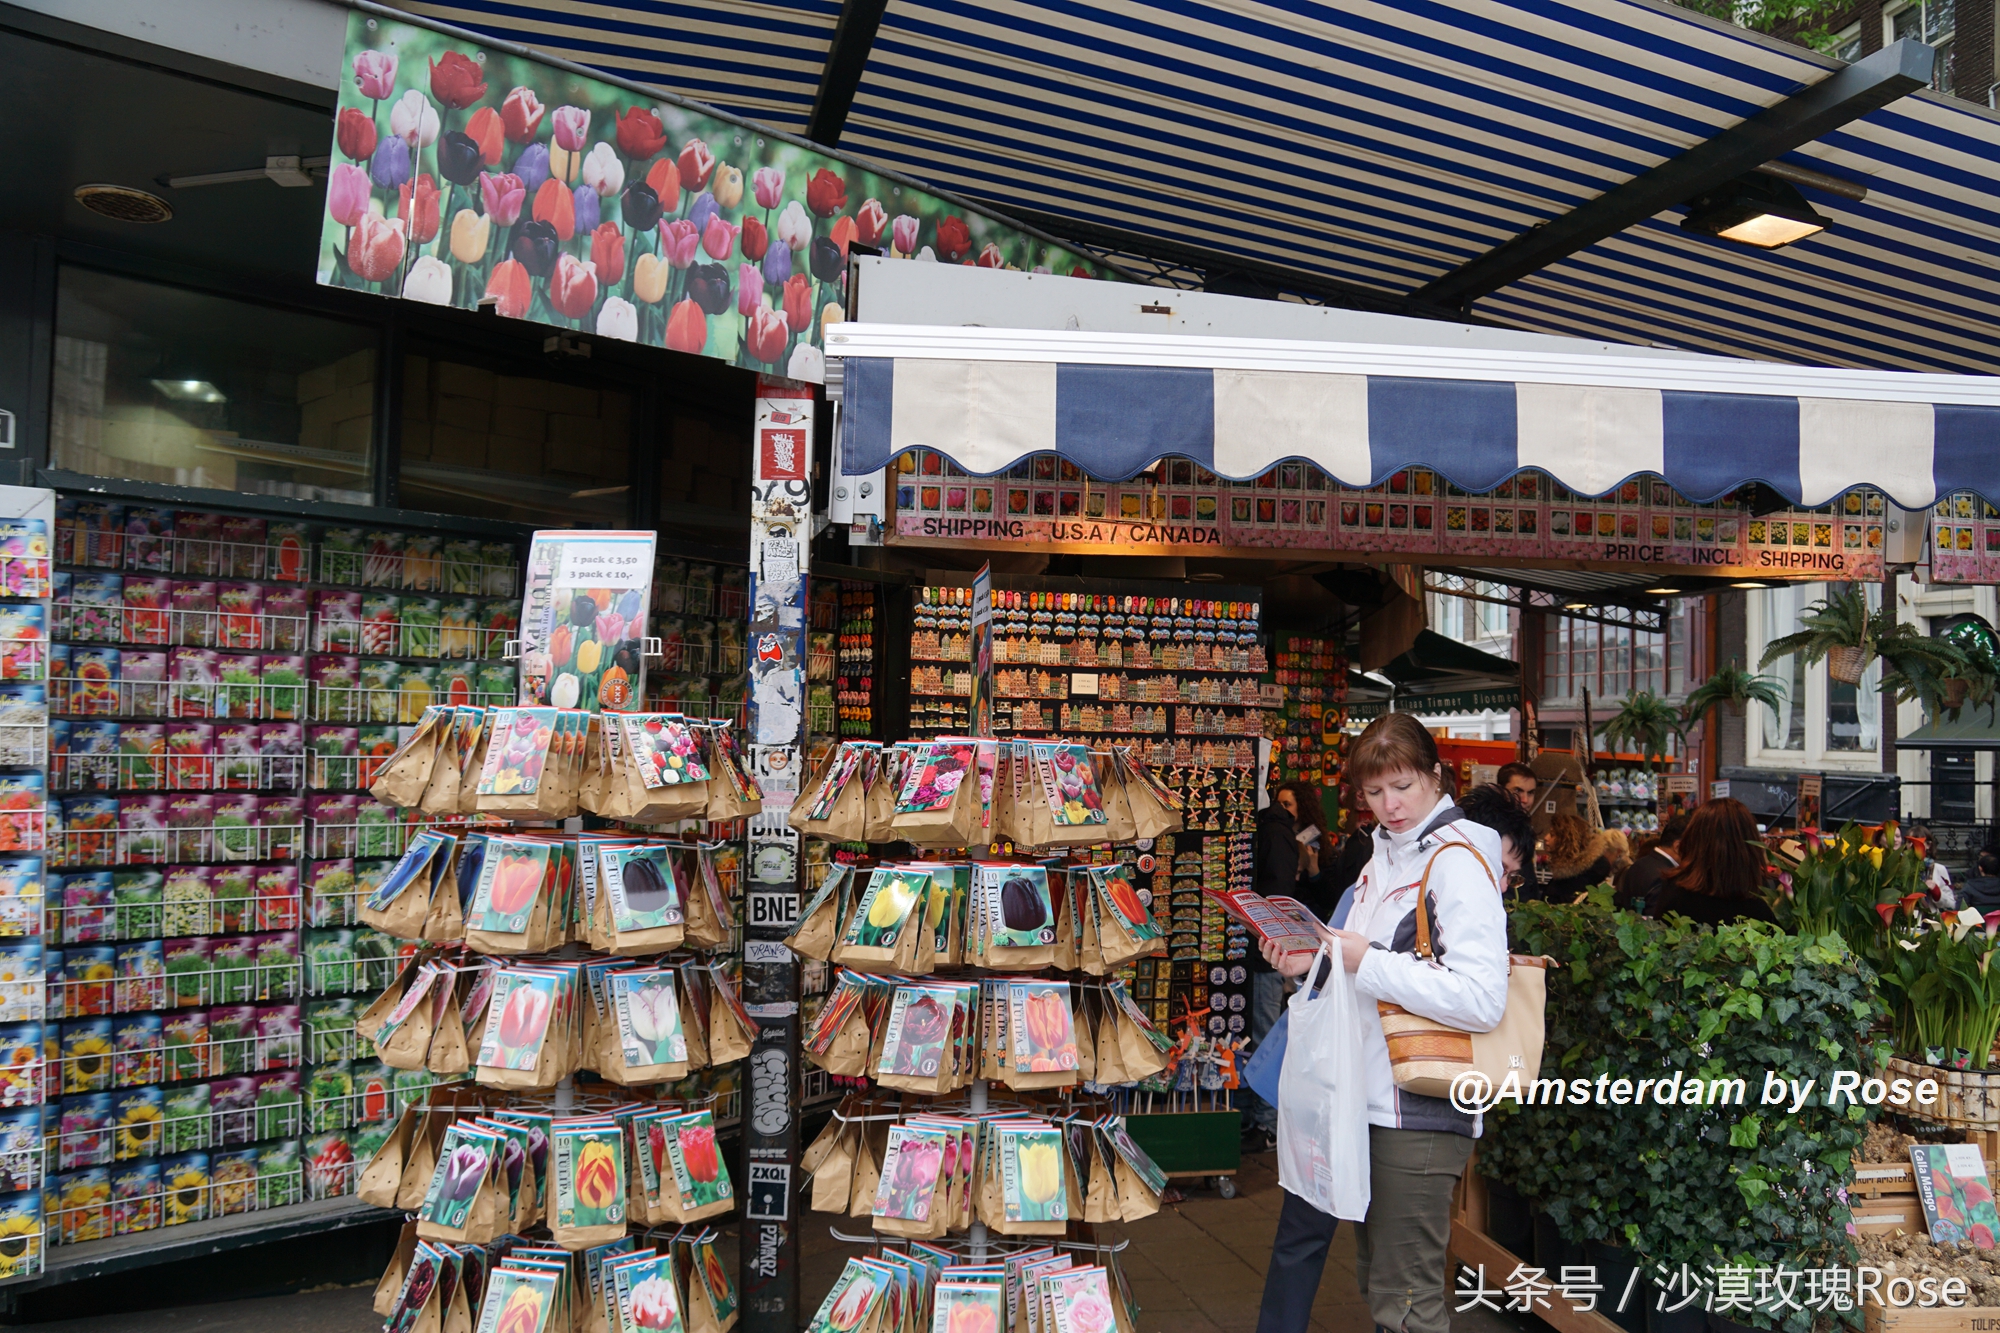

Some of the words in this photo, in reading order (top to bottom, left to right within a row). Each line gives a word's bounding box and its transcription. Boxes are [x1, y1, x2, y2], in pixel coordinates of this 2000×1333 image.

[923, 517, 1024, 538] SHIPPING
[1052, 523, 1103, 541] U.S.A
[1110, 526, 1117, 541] /
[1129, 525, 1221, 544] CANADA
[536, 546, 556, 560] 10
[580, 557, 606, 565] pack
[616, 557, 638, 565] 3,50
[1605, 544, 1664, 563] PRICE
[1692, 548, 1742, 565] INCL.
[1760, 551, 1844, 570] SHIPPING
[569, 571, 576, 579] 3
[578, 571, 604, 580] pack
[605, 571, 612, 579] €
[525, 568, 553, 654] TULIPA
[1427, 697, 1461, 707] Timmer
[1473, 693, 1519, 704] Bloemen
[487, 724, 507, 766] TULIPA
[1015, 744, 1024, 752] 10
[908, 757, 927, 791] TULIPA
[1014, 756, 1024, 798] TULIPA
[1039, 759, 1055, 798] TULIPA
[582, 845, 593, 853] 10
[479, 858, 498, 899] TULIPA
[583, 856, 595, 900] TULIPA
[608, 865, 622, 905] TULIPA
[754, 897, 796, 922] BNE
[856, 883, 879, 919] TULIPA
[988, 884, 999, 922] TULIPA
[1101, 882, 1123, 920] TULIPA
[616, 979, 627, 988] 10
[897, 992, 907, 1000] 10
[487, 989, 507, 1034] TULIPA
[618, 991, 630, 1037] TULIPA
[887, 1004, 906, 1044] TULIPA
[997, 996, 1007, 1038] TULIPA
[1013, 1000, 1024, 1044] TULIPA
[558, 1138, 570, 1146] 10
[637, 1121, 645, 1130] 10
[665, 1124, 675, 1133] 10
[891, 1132, 900, 1141] 10
[1004, 1135, 1014, 1143] 10
[431, 1147, 453, 1190] TULIPA
[638, 1132, 651, 1178] TULIPA
[667, 1137, 683, 1180] TULIPA
[880, 1144, 899, 1187] TULIPA
[1004, 1147, 1016, 1191] TULIPA
[558, 1150, 570, 1197] TULIPA
[753, 1167, 787, 1181] ZXQL
[1914, 1149, 1927, 1174] Calla
[1921, 1175, 1937, 1212] Mango
[492, 1276, 504, 1284] 10
[605, 1265, 614, 1273] 10
[617, 1273, 628, 1281] 10
[1008, 1262, 1016, 1271] 10
[1025, 1270, 1034, 1278] 10
[822, 1275, 850, 1311] TULIPA
[938, 1292, 949, 1300] 10
[1008, 1273, 1017, 1315] TULIPA
[1027, 1280, 1036, 1324] TULIPA
[1052, 1281, 1063, 1289] 10
[619, 1285, 632, 1331] TULIPA
